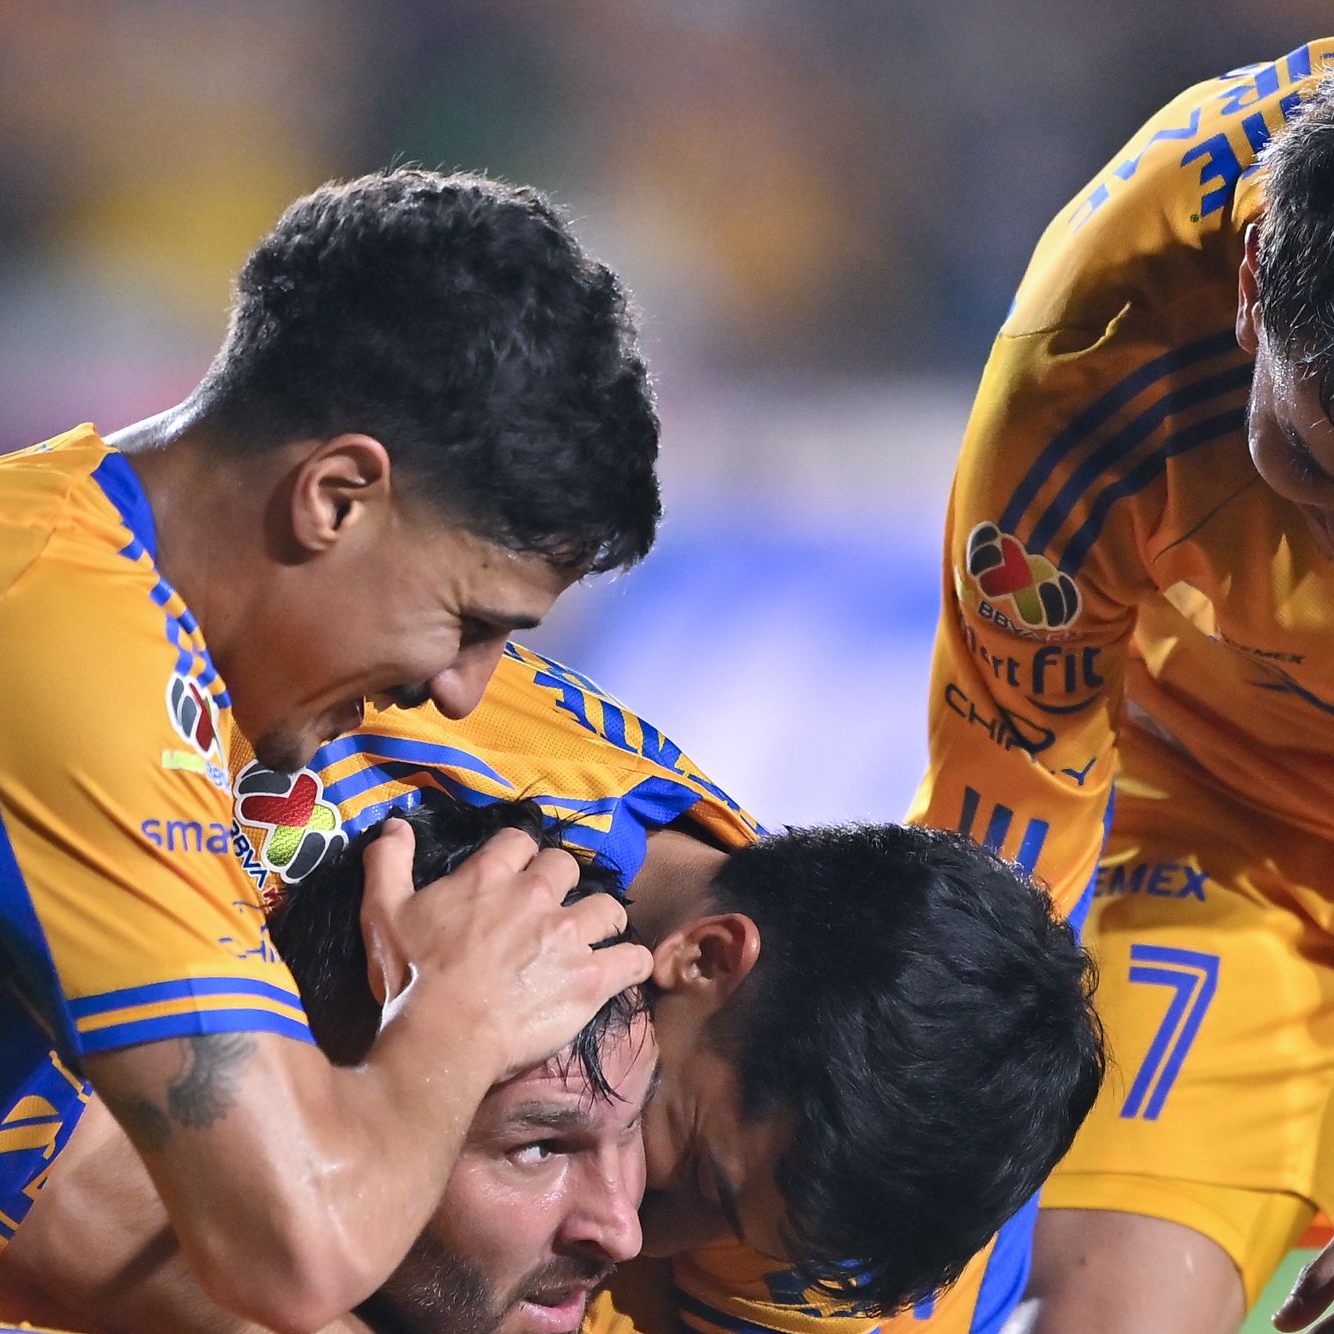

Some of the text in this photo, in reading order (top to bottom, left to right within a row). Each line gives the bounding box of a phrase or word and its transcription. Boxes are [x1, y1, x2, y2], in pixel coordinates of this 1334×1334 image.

[978, 600, 1042, 644] BBVA
[1094, 862, 1208, 902] EMEX
[1119, 943, 1221, 1121] 7
